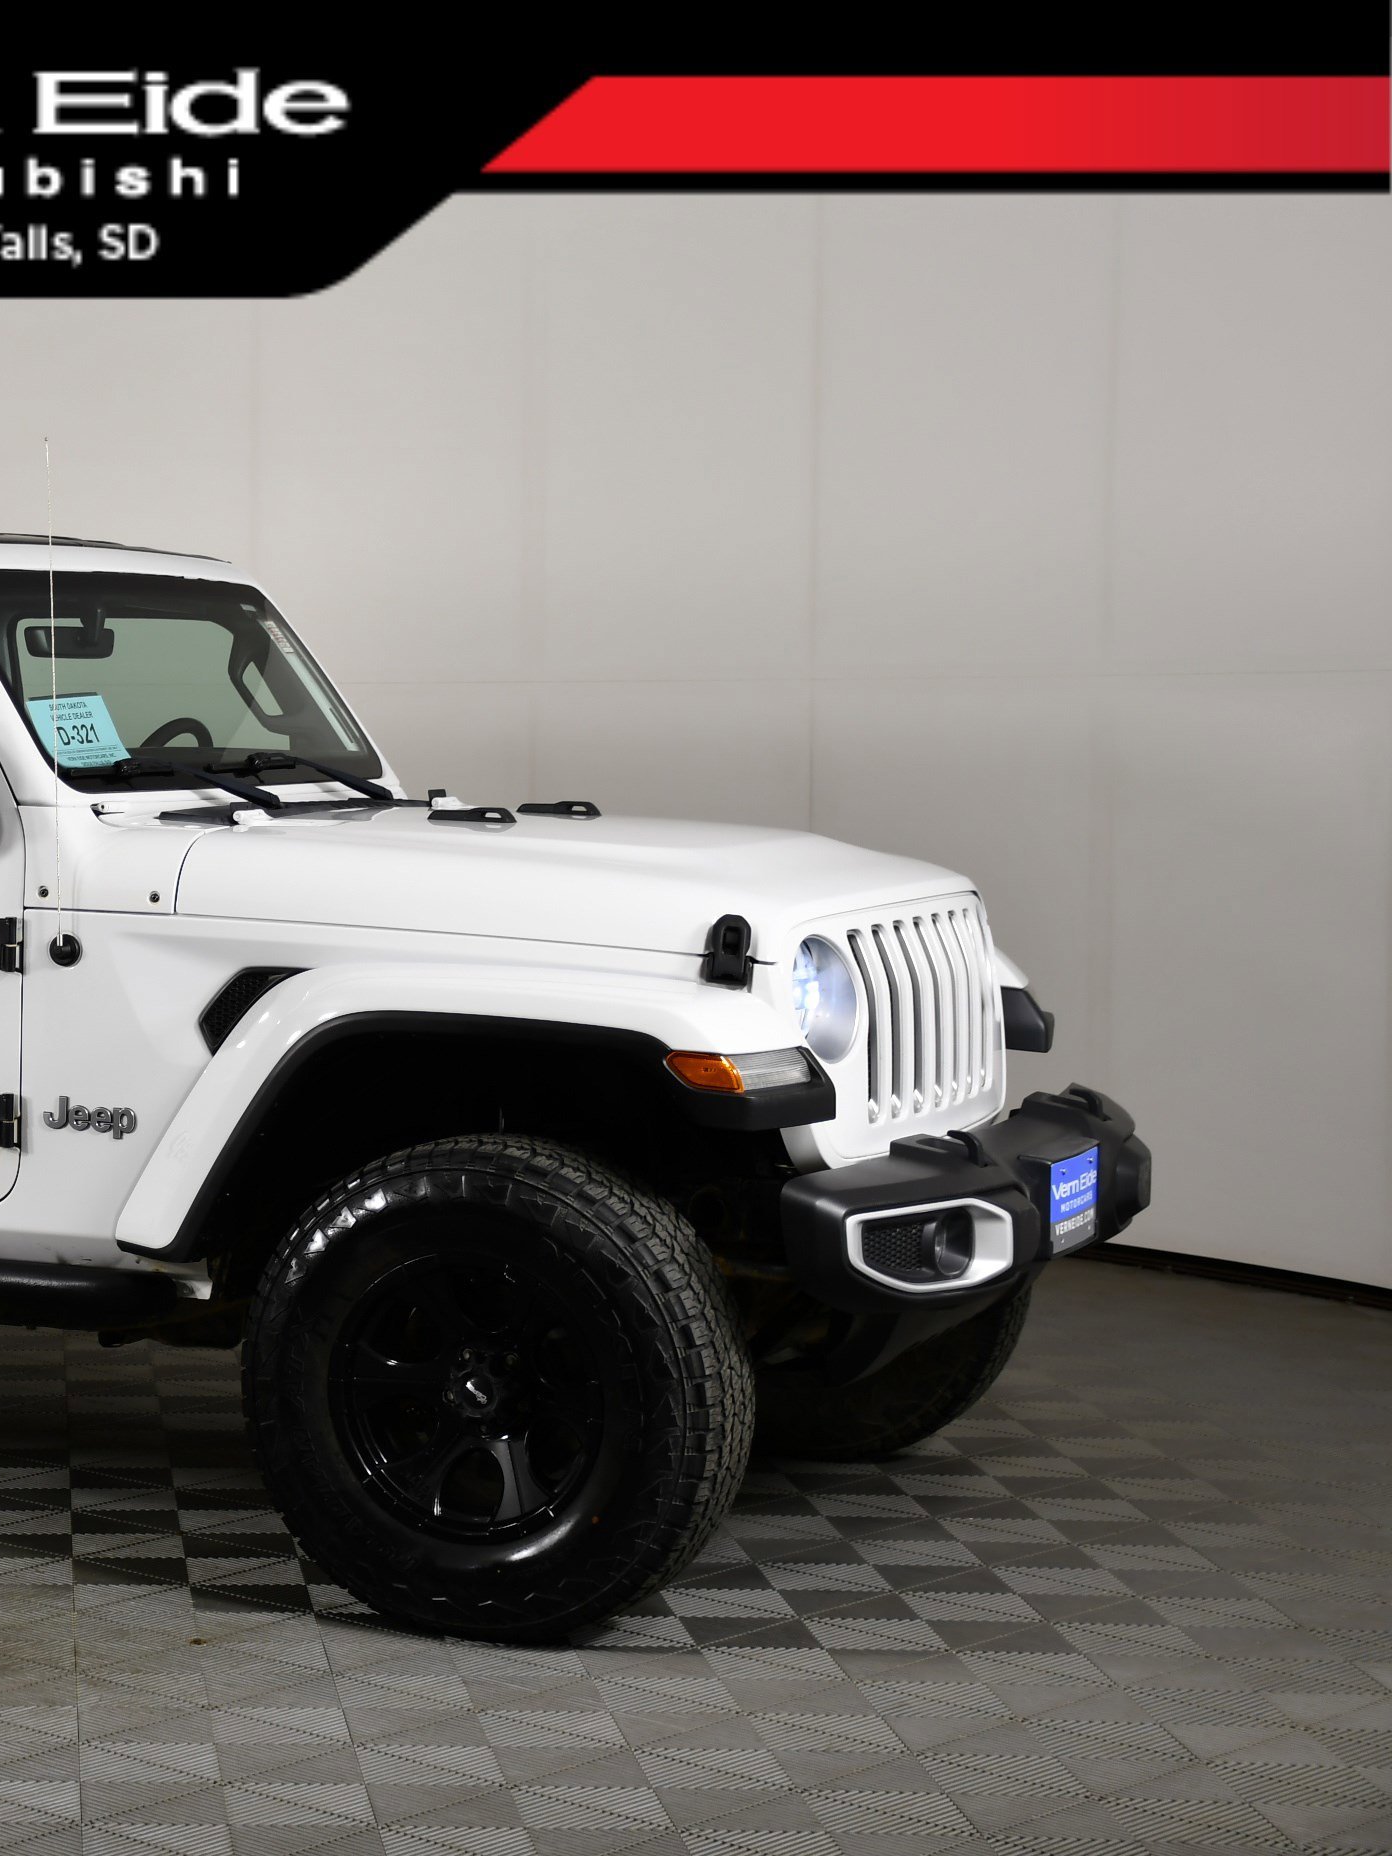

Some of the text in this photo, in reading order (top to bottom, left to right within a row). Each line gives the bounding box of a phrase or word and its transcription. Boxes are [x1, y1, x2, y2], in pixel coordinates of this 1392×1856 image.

[67, 701, 87, 709] DAKOTA
[72, 711, 93, 719] DEALER
[56, 724, 99, 746] D-321
[43, 1095, 137, 1140] Jeep
[1052, 1169, 1097, 1200] Vern Eide
[1061, 1191, 1093, 1212] MOTORCARS
